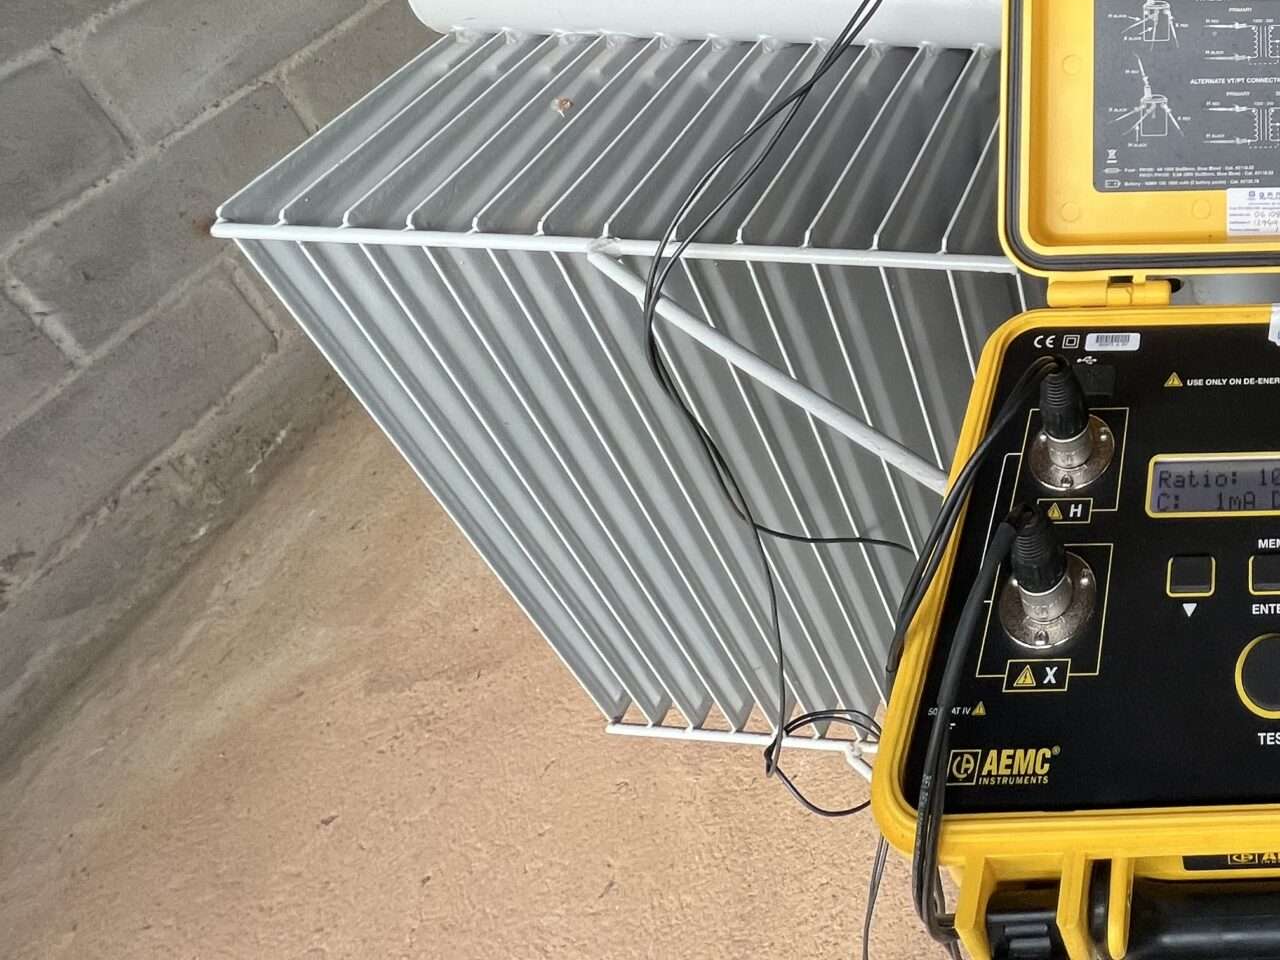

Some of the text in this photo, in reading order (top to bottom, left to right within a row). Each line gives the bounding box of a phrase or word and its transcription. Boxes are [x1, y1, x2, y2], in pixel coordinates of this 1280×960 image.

[1186, 378, 1204, 387] USE
[1205, 377, 1228, 386] ONLY
[1229, 377, 1242, 385] ON
[1158, 470, 1238, 489] Ratio:
[1156, 492, 1181, 511] C:
[1215, 491, 1257, 511] 1mA
[1069, 504, 1082, 518] H
[1042, 666, 1058, 684] X
[962, 707, 971, 715] IV
[978, 775, 1049, 785] INSTRUMENTS
